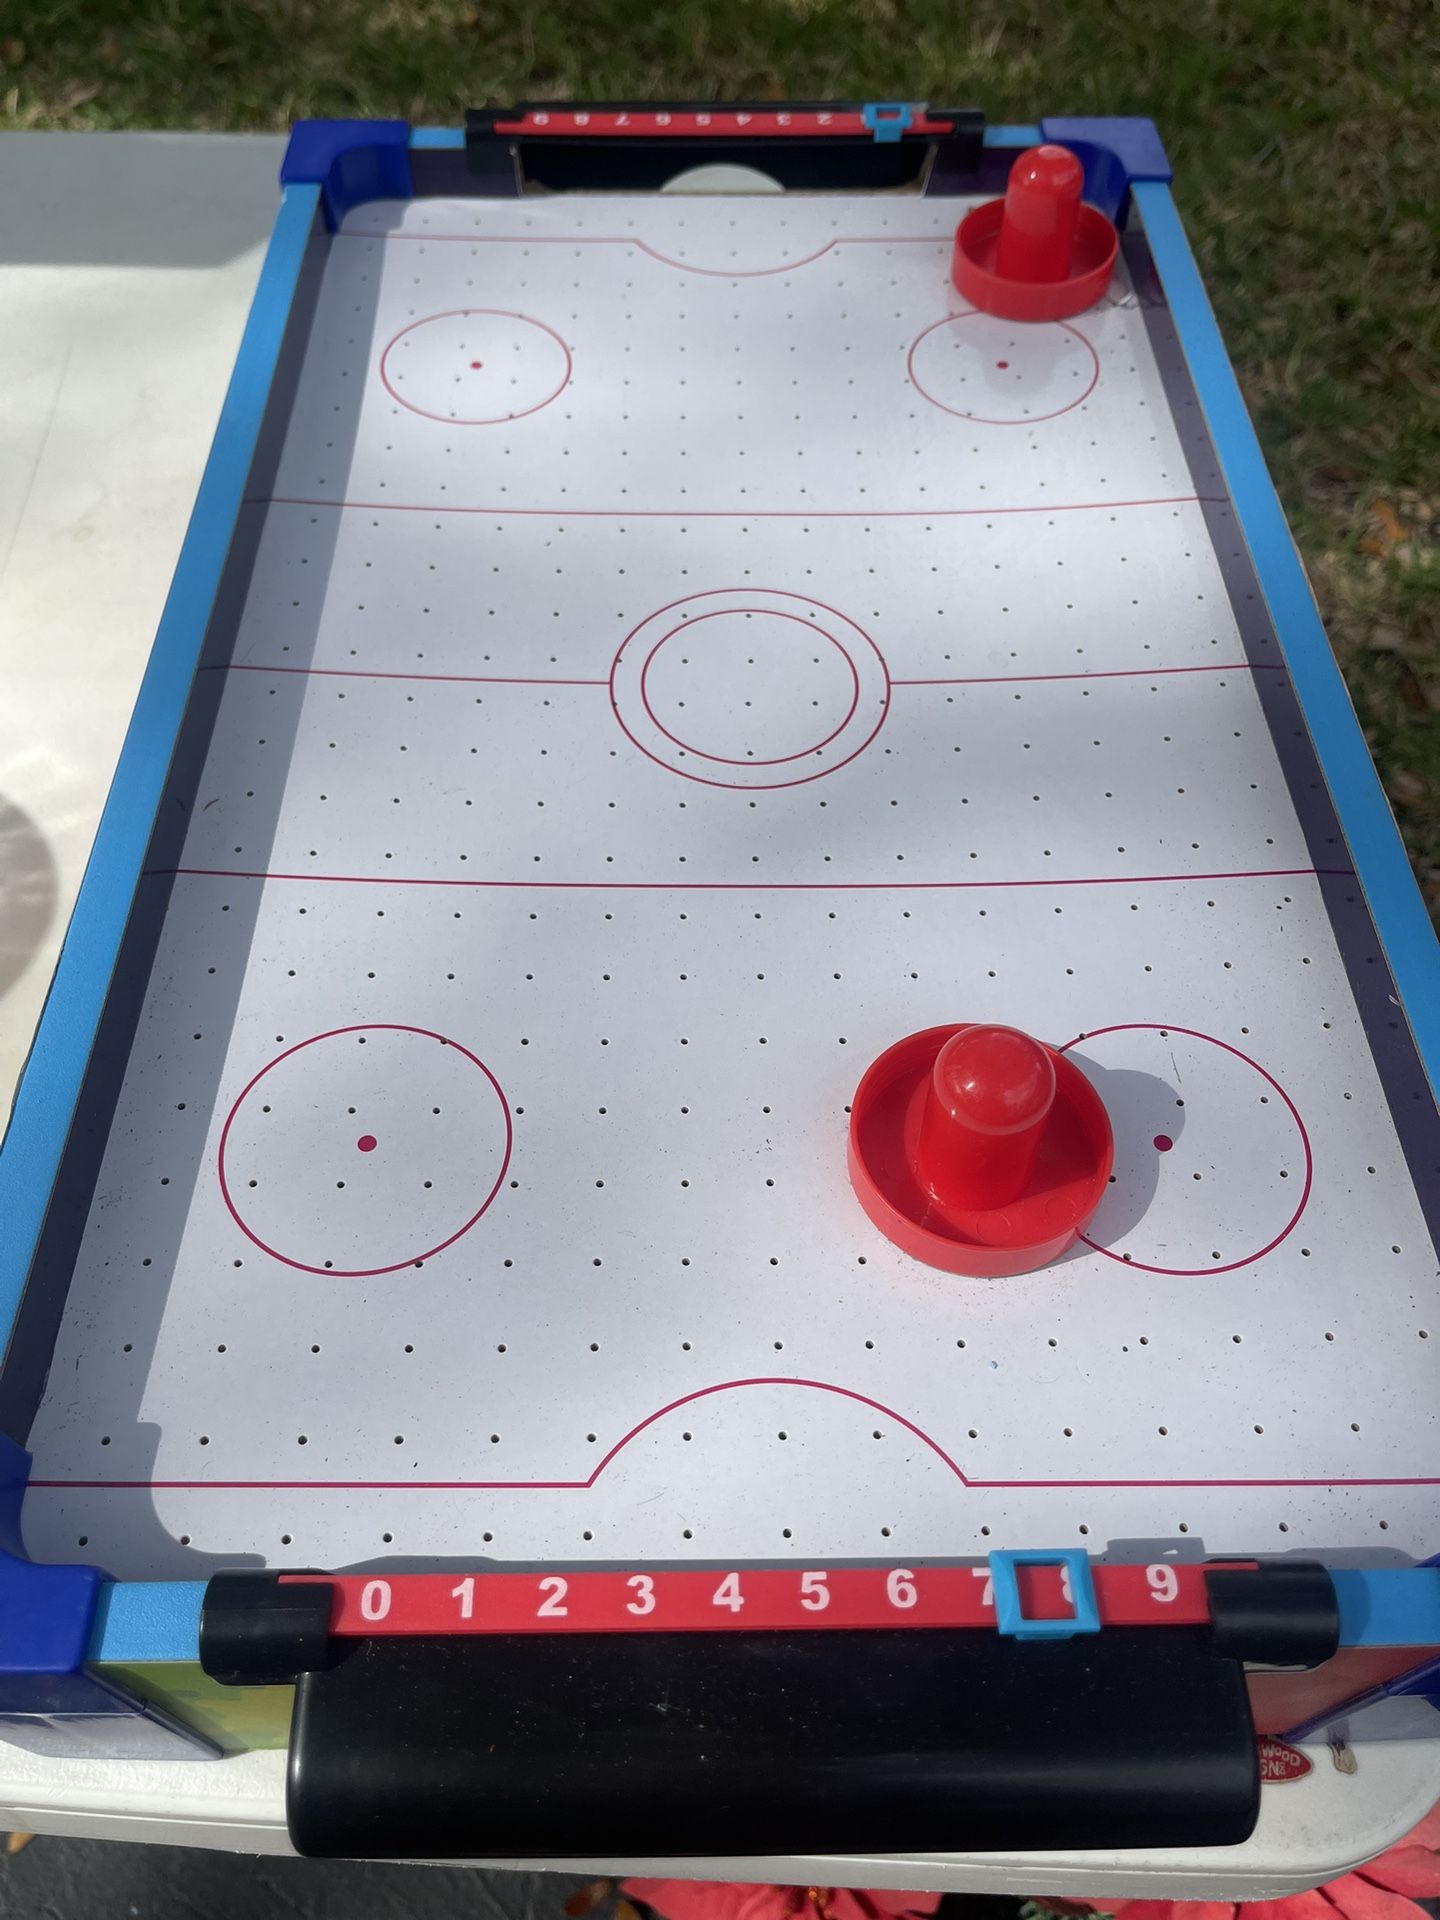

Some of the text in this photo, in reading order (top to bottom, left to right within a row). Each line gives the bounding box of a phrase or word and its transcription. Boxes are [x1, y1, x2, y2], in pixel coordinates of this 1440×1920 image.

[533, 113, 832, 126] 2 3 4 5 6 7 8 9
[360, 1563, 1179, 1621] 0 1 2 3 4 5 6 7 9
[1259, 1744, 1300, 1766] WOOD
